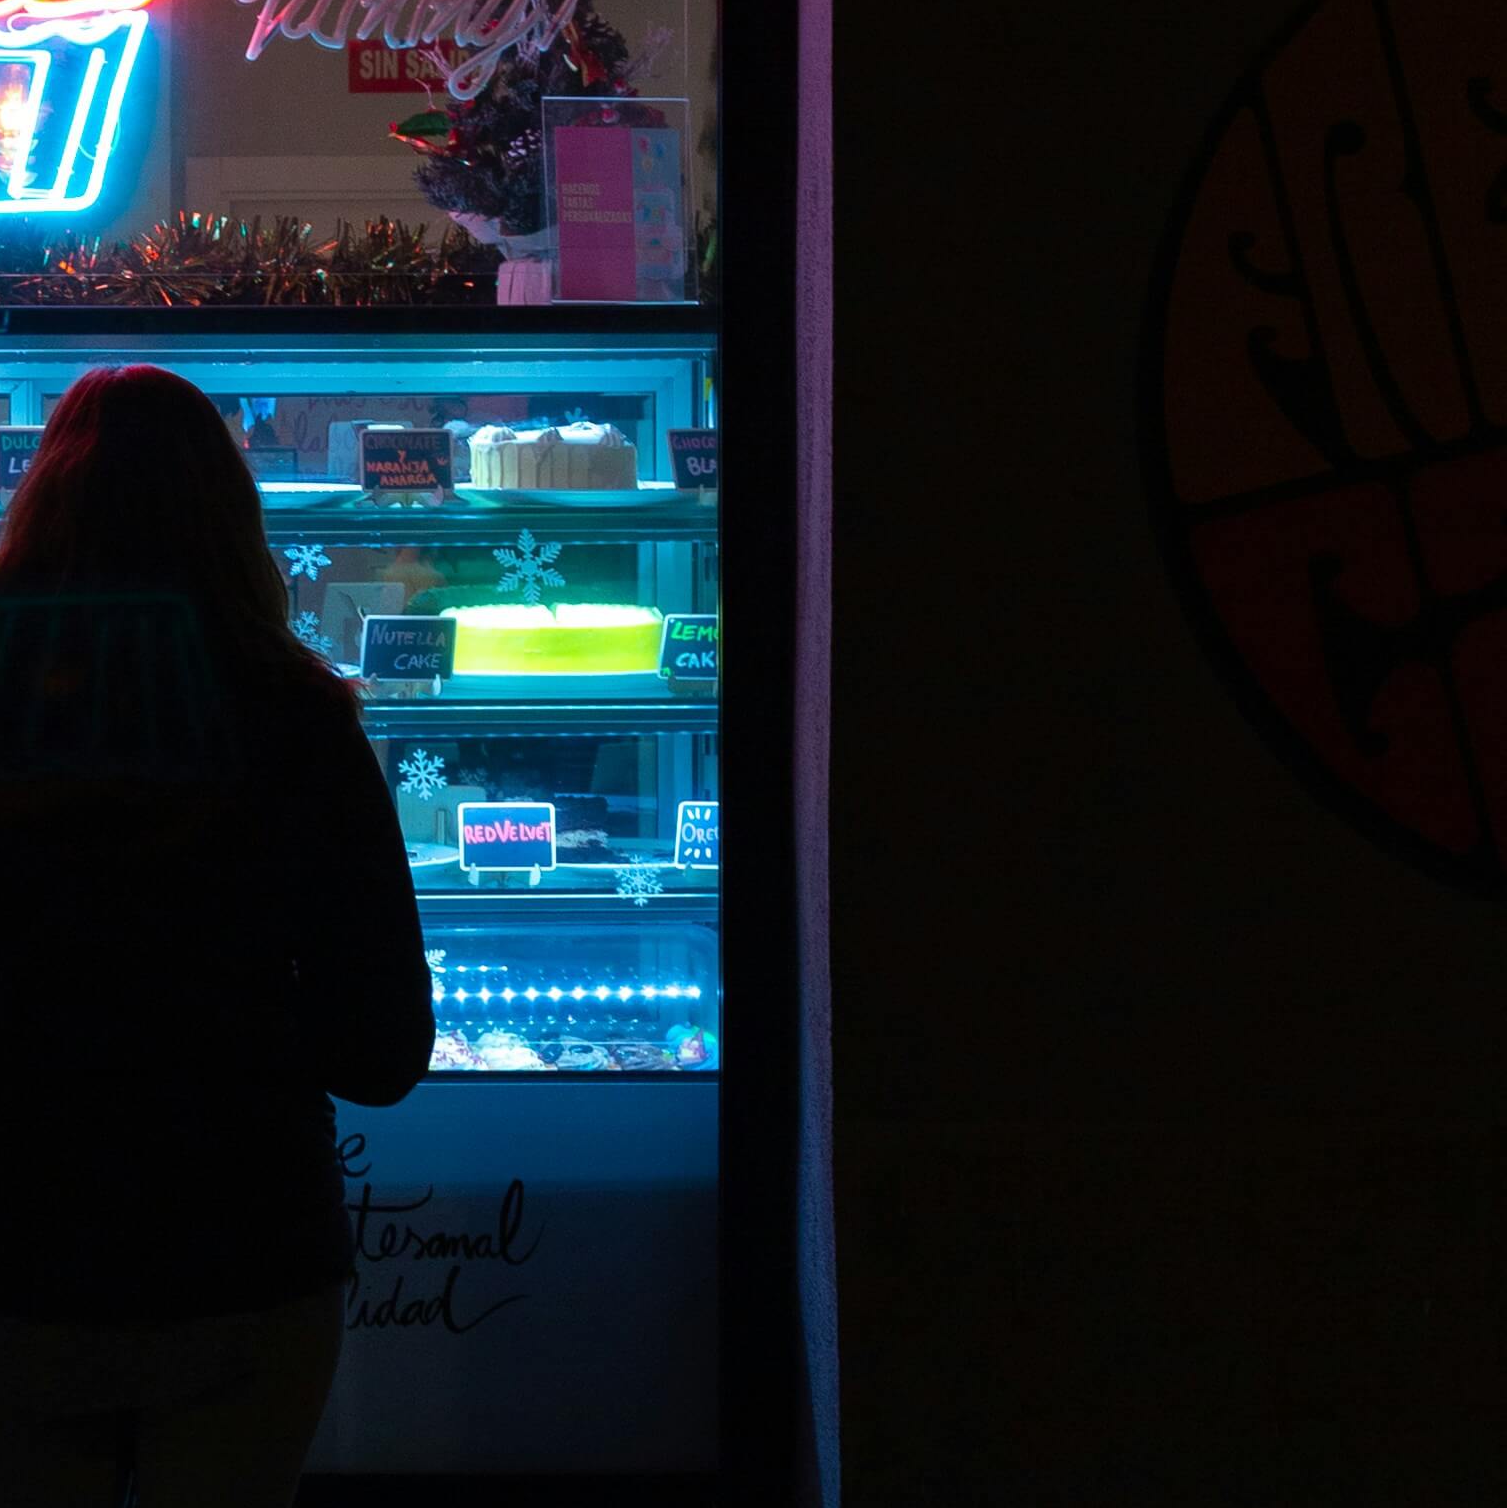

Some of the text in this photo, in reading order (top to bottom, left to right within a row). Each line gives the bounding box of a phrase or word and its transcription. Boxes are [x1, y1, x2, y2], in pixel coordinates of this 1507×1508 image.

[359, 49, 399, 80] SIN
[1, 435, 42, 451] DULC
[366, 460, 429, 474] NARANJA
[379, 473, 438, 487] AMARGA
[370, 623, 446, 647] NUTELLA
[394, 653, 443, 670] CAKE
[676, 650, 715, 669] CAK
[347, 1179, 545, 1265] tesanal
